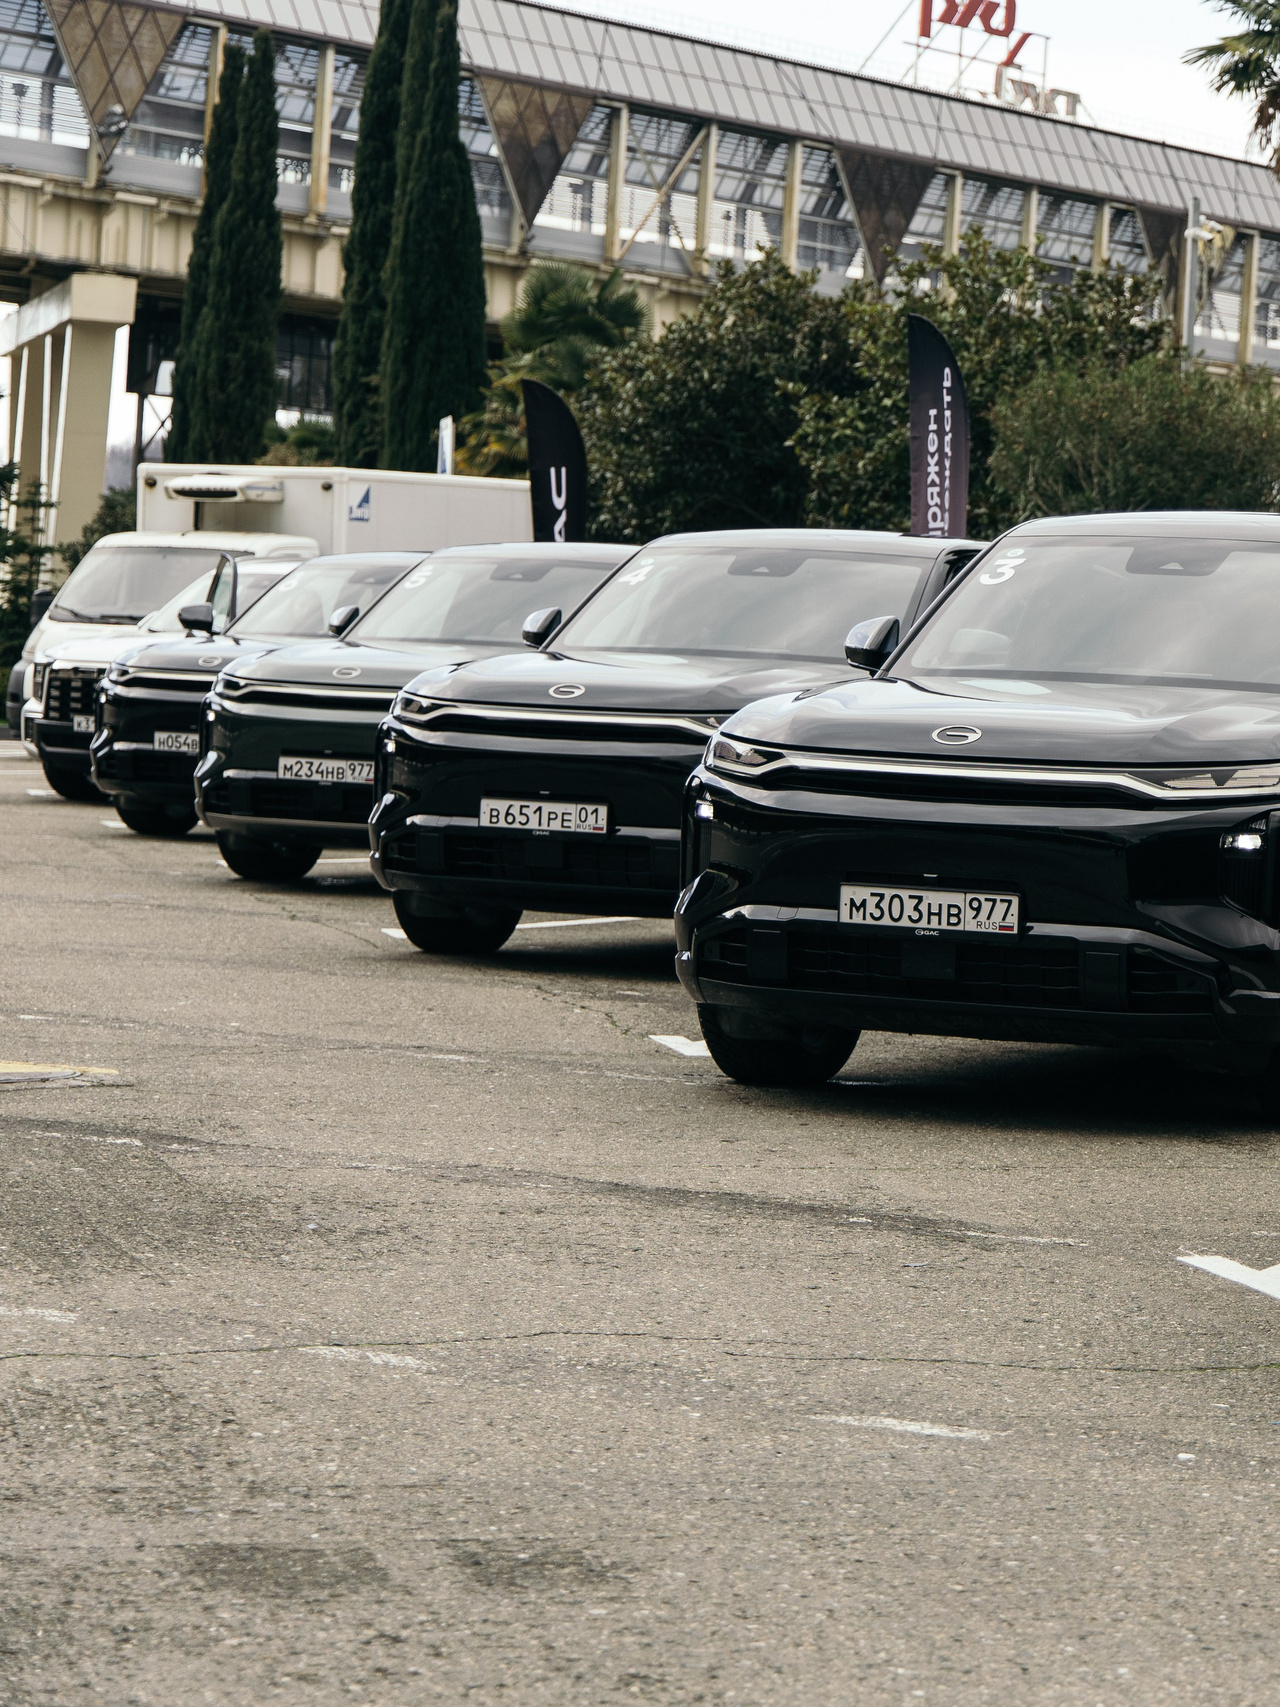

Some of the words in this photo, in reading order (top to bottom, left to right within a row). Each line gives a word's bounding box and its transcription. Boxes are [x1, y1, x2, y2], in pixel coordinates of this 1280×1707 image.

[927, 408, 944, 536] ряжен
[550, 466, 567, 542] AC
[618, 565, 654, 585] 4
[979, 558, 1027, 585] 3
[158, 734, 198, 750] Н054В
[283, 760, 345, 780] М234НВ
[348, 762, 373, 777] 977
[489, 804, 572, 829] В651РЕ
[578, 807, 599, 824] 01
[849, 892, 962, 927] М303НВ
[968, 896, 1013, 922] 977
[976, 921, 998, 930] RUS
